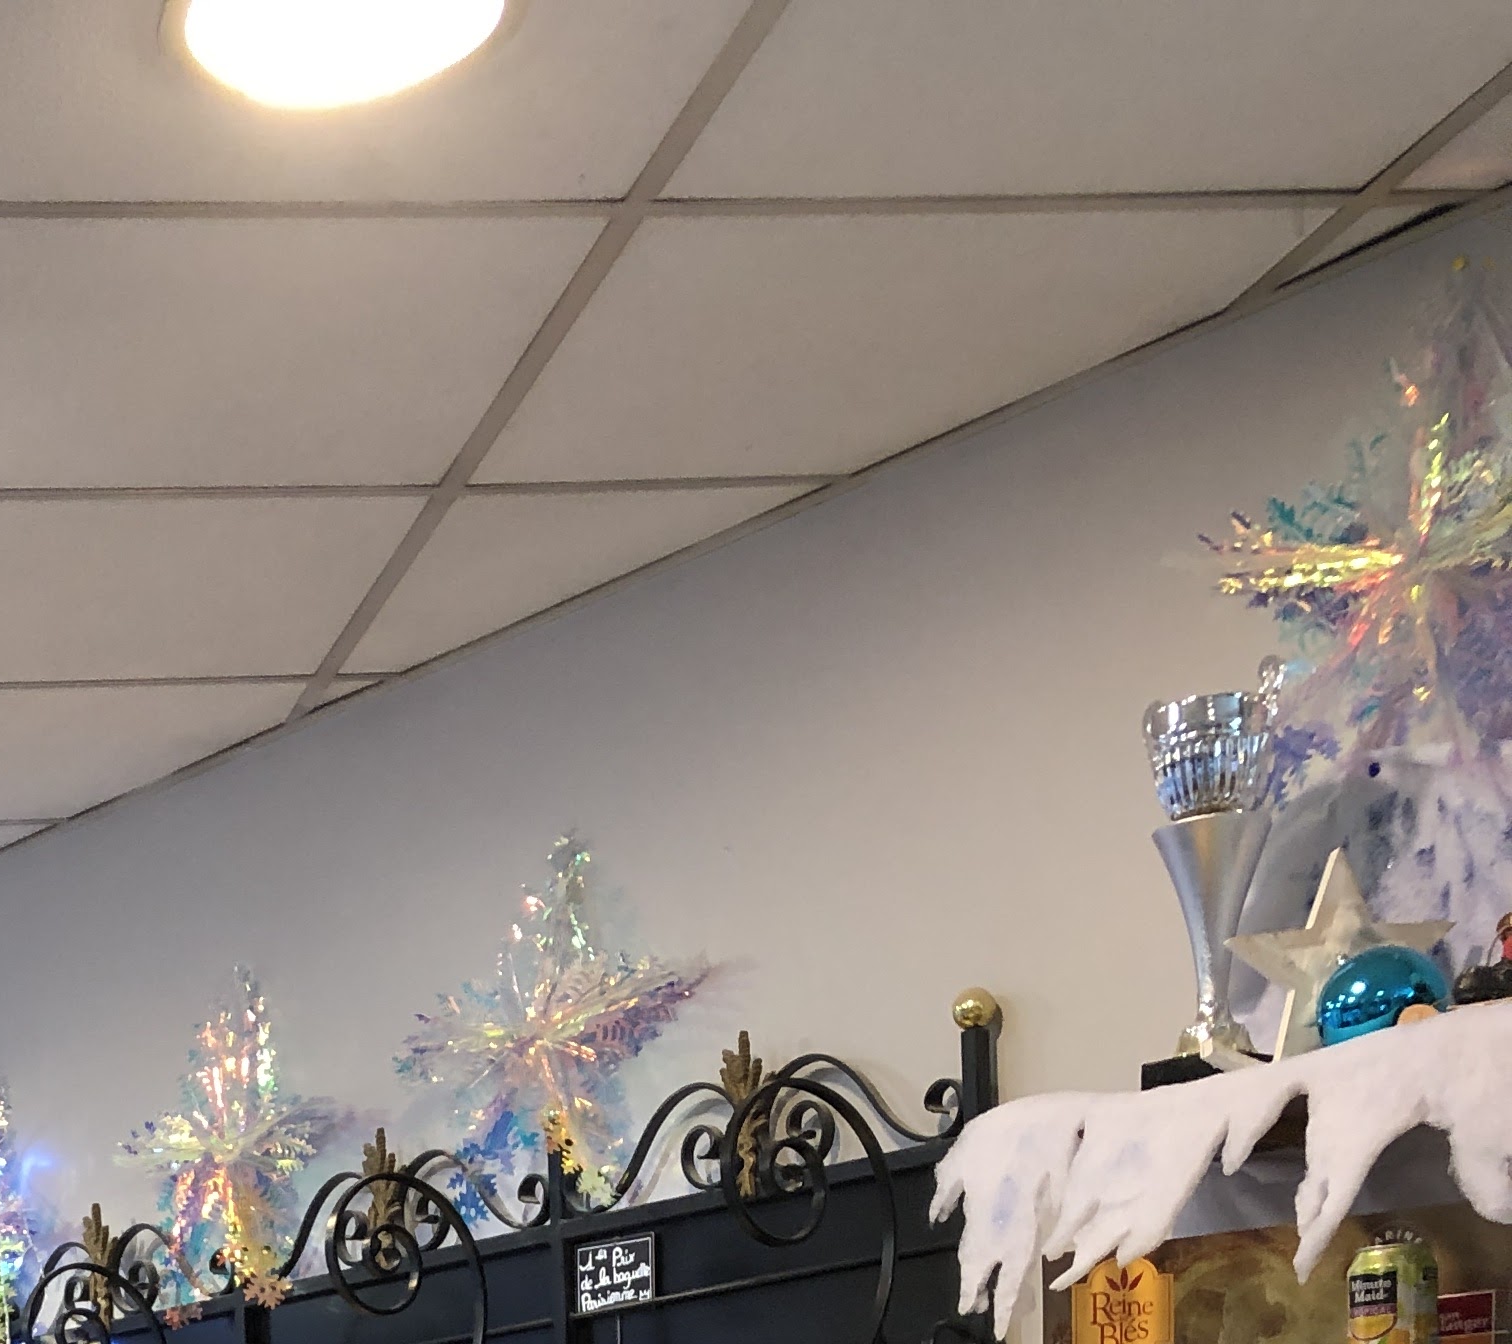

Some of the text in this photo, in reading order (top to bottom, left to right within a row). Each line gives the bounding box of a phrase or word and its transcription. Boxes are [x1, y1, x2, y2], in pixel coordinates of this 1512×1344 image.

[612, 1246, 636, 1268] Prix
[581, 1262, 651, 1291] de la baguette
[1351, 1278, 1392, 1293] Minute
[1354, 1289, 1388, 1303] Maid
[1090, 1292, 1154, 1326] Reine
